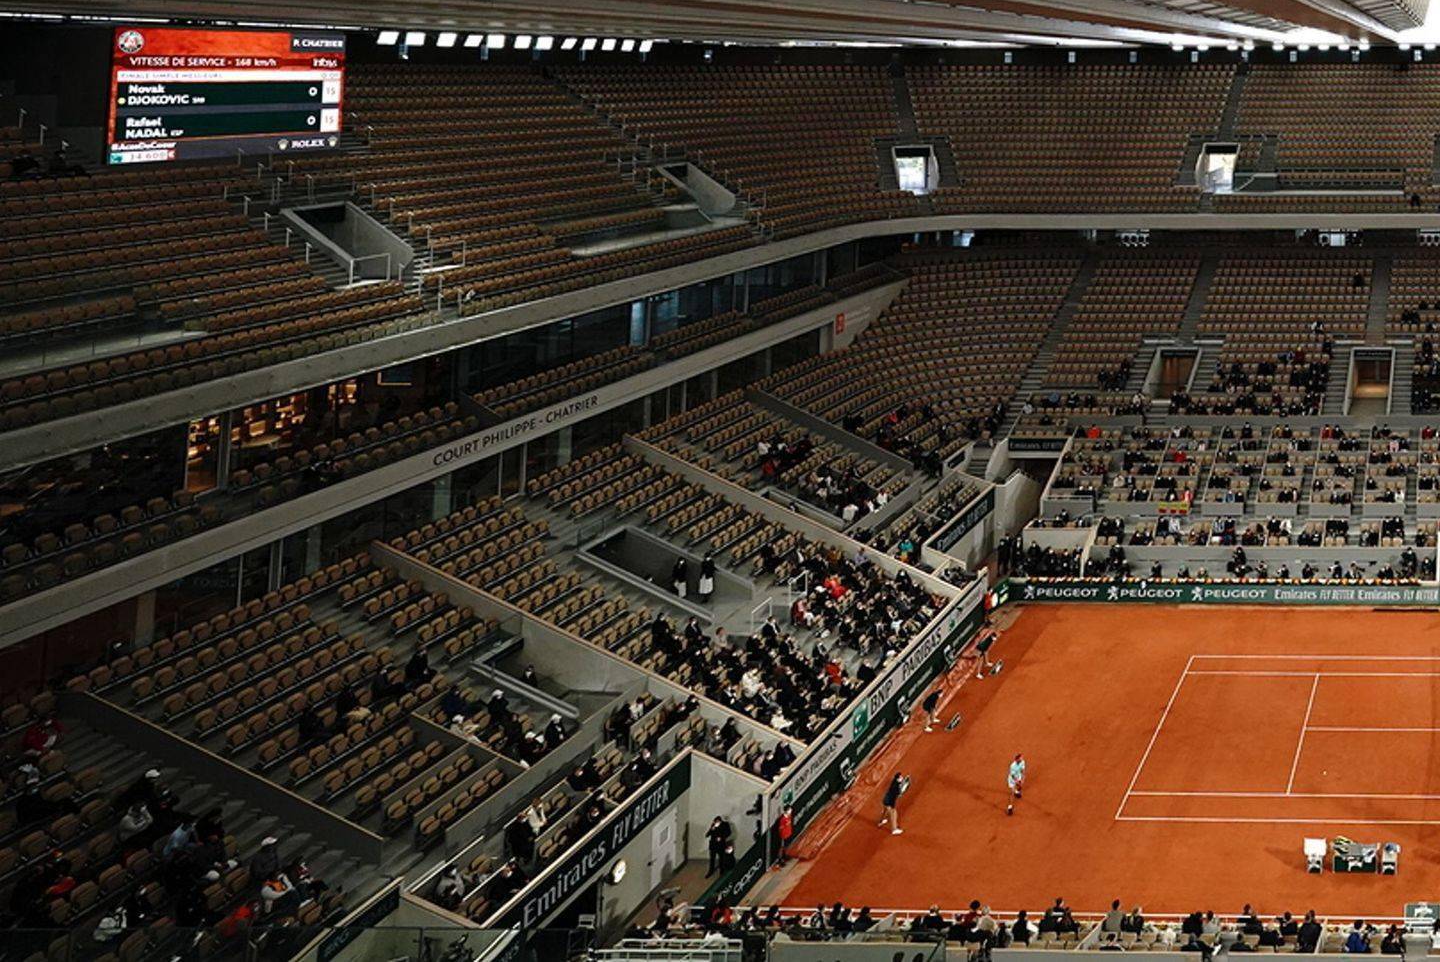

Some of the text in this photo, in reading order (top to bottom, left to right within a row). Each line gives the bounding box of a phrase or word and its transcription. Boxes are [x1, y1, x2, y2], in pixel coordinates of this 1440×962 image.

[129, 56, 170, 67] VITESSE
[172, 57, 185, 67] DE
[187, 57, 226, 68] SERVICE
[254, 58, 277, 68] km/h
[128, 84, 165, 94] Novak
[127, 95, 190, 105] DJOKOVIC
[126, 116, 162, 128] Rafael
[125, 128, 168, 139] NADAL
[291, 139, 325, 149] ROLEX
[433, 439, 480, 466] COURT
[482, 418, 536, 448] PHILIPPE
[545, 395, 598, 424] CHATRIER
[1036, 587, 1100, 598] PEUGEOT
[1120, 588, 1183, 598] PEUGEOT
[1204, 588, 1267, 599] PEUGEOT
[1274, 589, 1317, 600] Emirates
[1357, 589, 1401, 600] Emirates
[870, 679, 893, 715] BNP
[901, 627, 942, 680] PARIBAS
[523, 779, 670, 928] Emirates FLY BETTER
